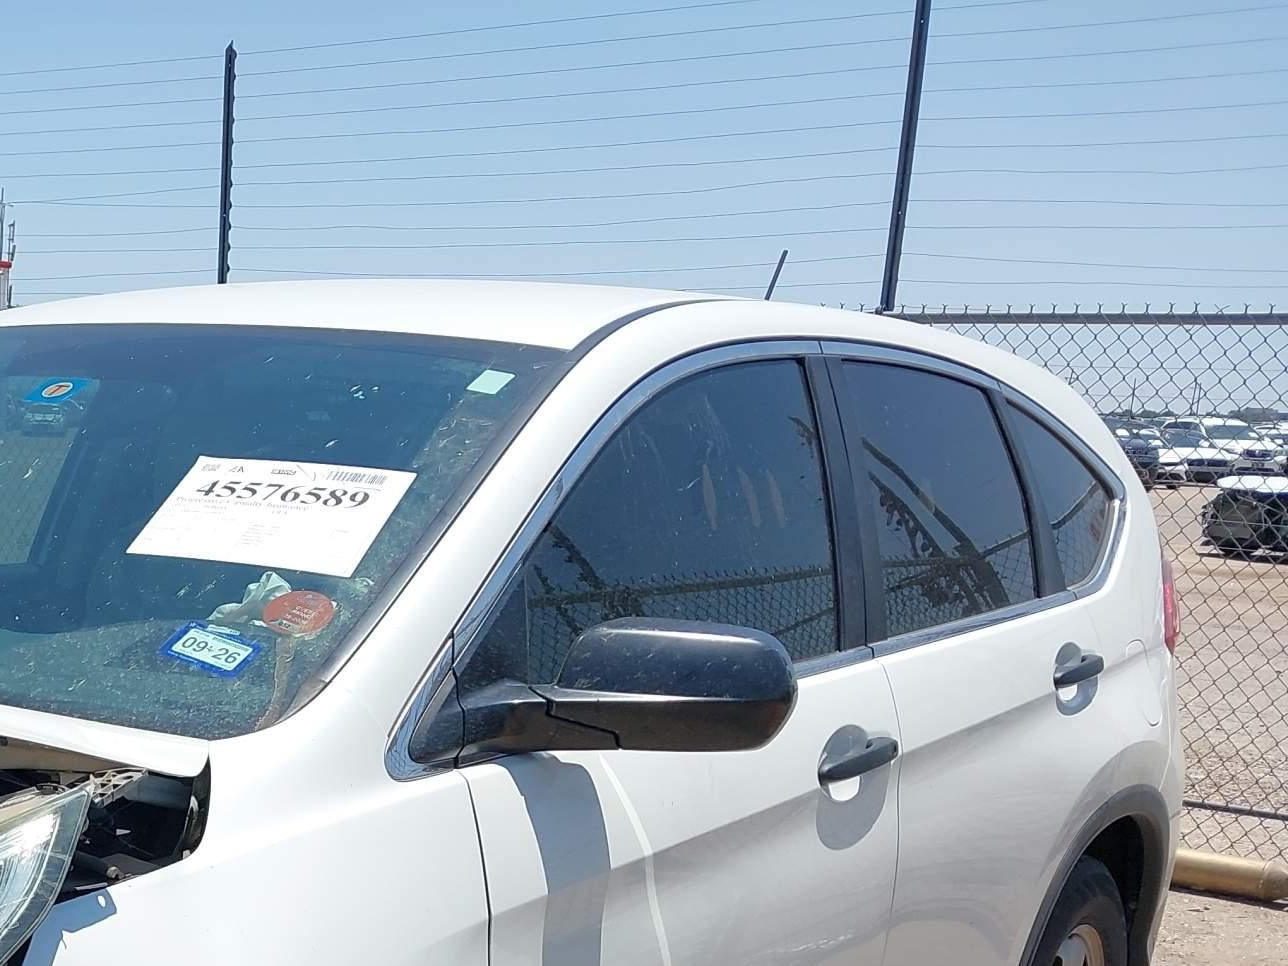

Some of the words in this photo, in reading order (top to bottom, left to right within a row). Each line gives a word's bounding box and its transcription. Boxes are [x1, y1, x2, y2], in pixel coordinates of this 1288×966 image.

[196, 479, 370, 509] 45576589
[181, 636, 208, 653] 09
[212, 647, 241, 664] 26
